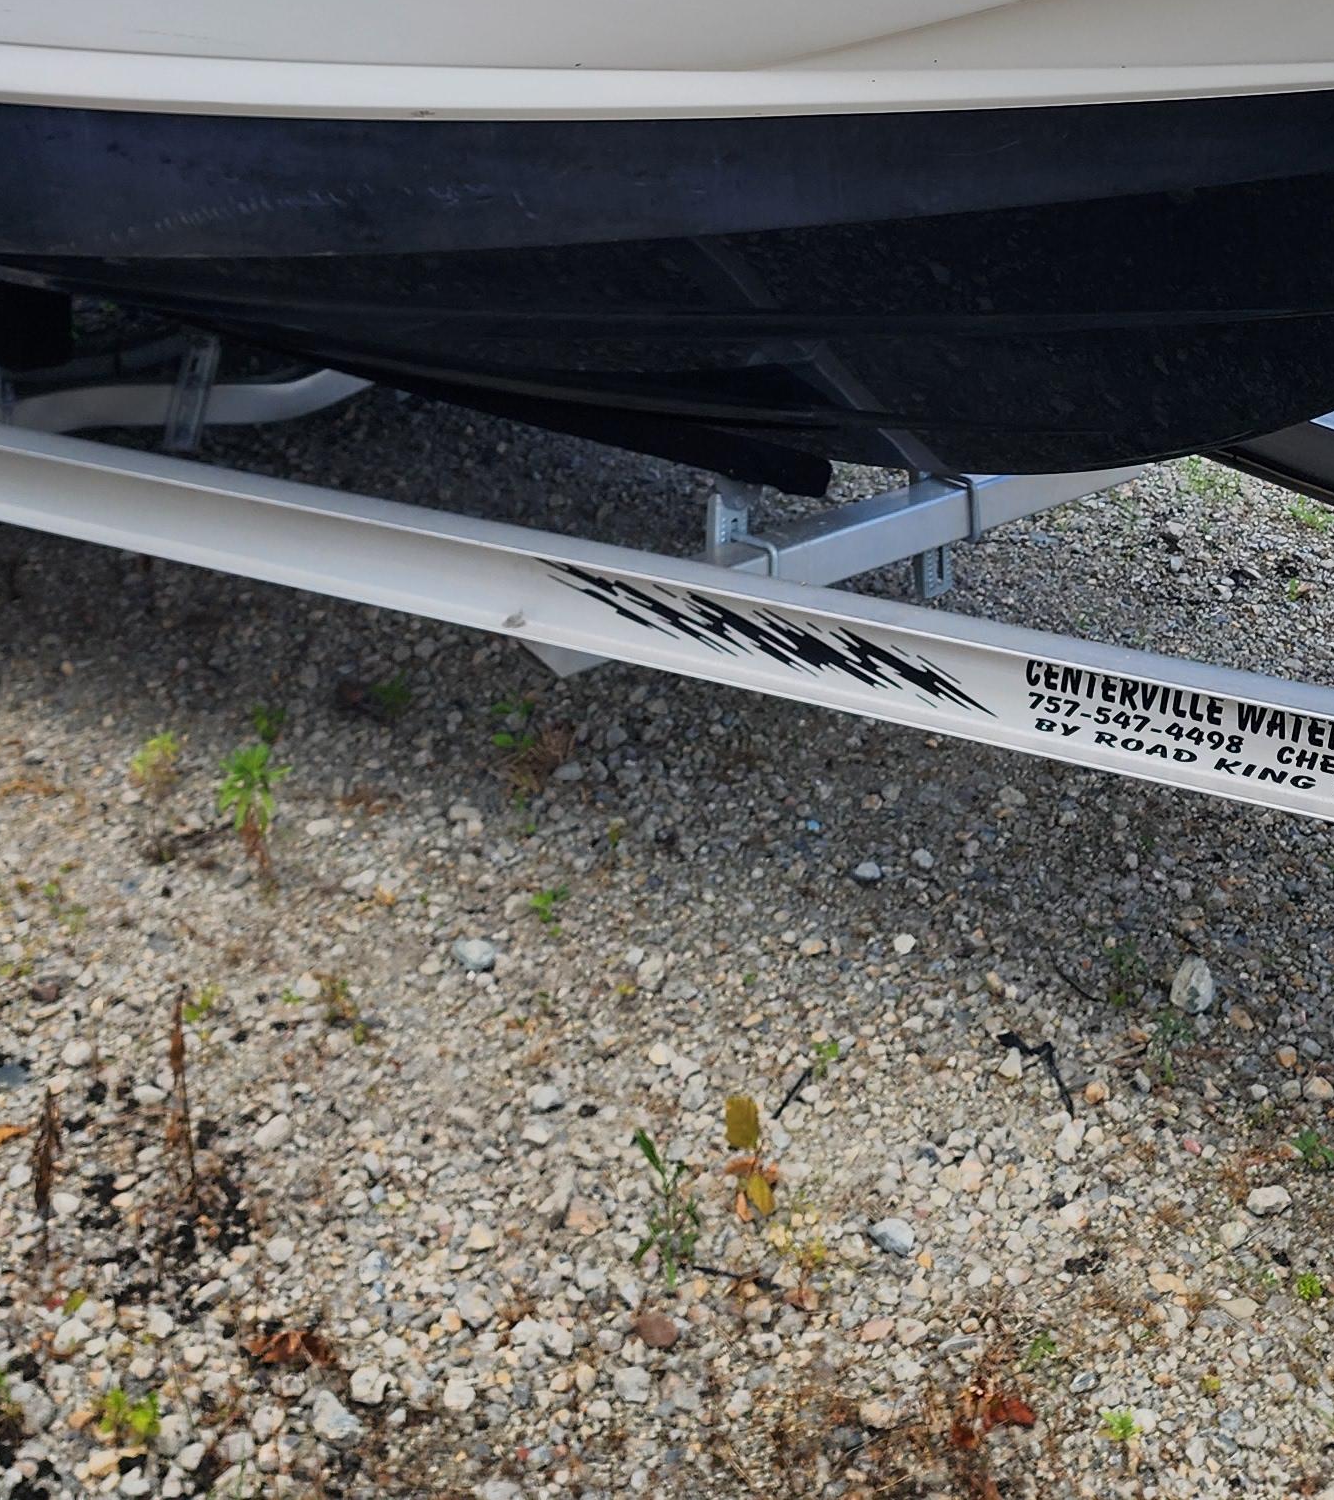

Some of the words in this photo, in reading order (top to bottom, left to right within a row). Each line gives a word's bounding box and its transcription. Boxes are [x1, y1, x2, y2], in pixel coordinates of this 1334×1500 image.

[1026, 659, 1225, 726] CENTERVILLE
[1028, 692, 1244, 754] 757-547-4498
[1035, 718, 1081, 736] BY
[1094, 731, 1197, 763] ROAD
[1214, 757, 1316, 790] KING
